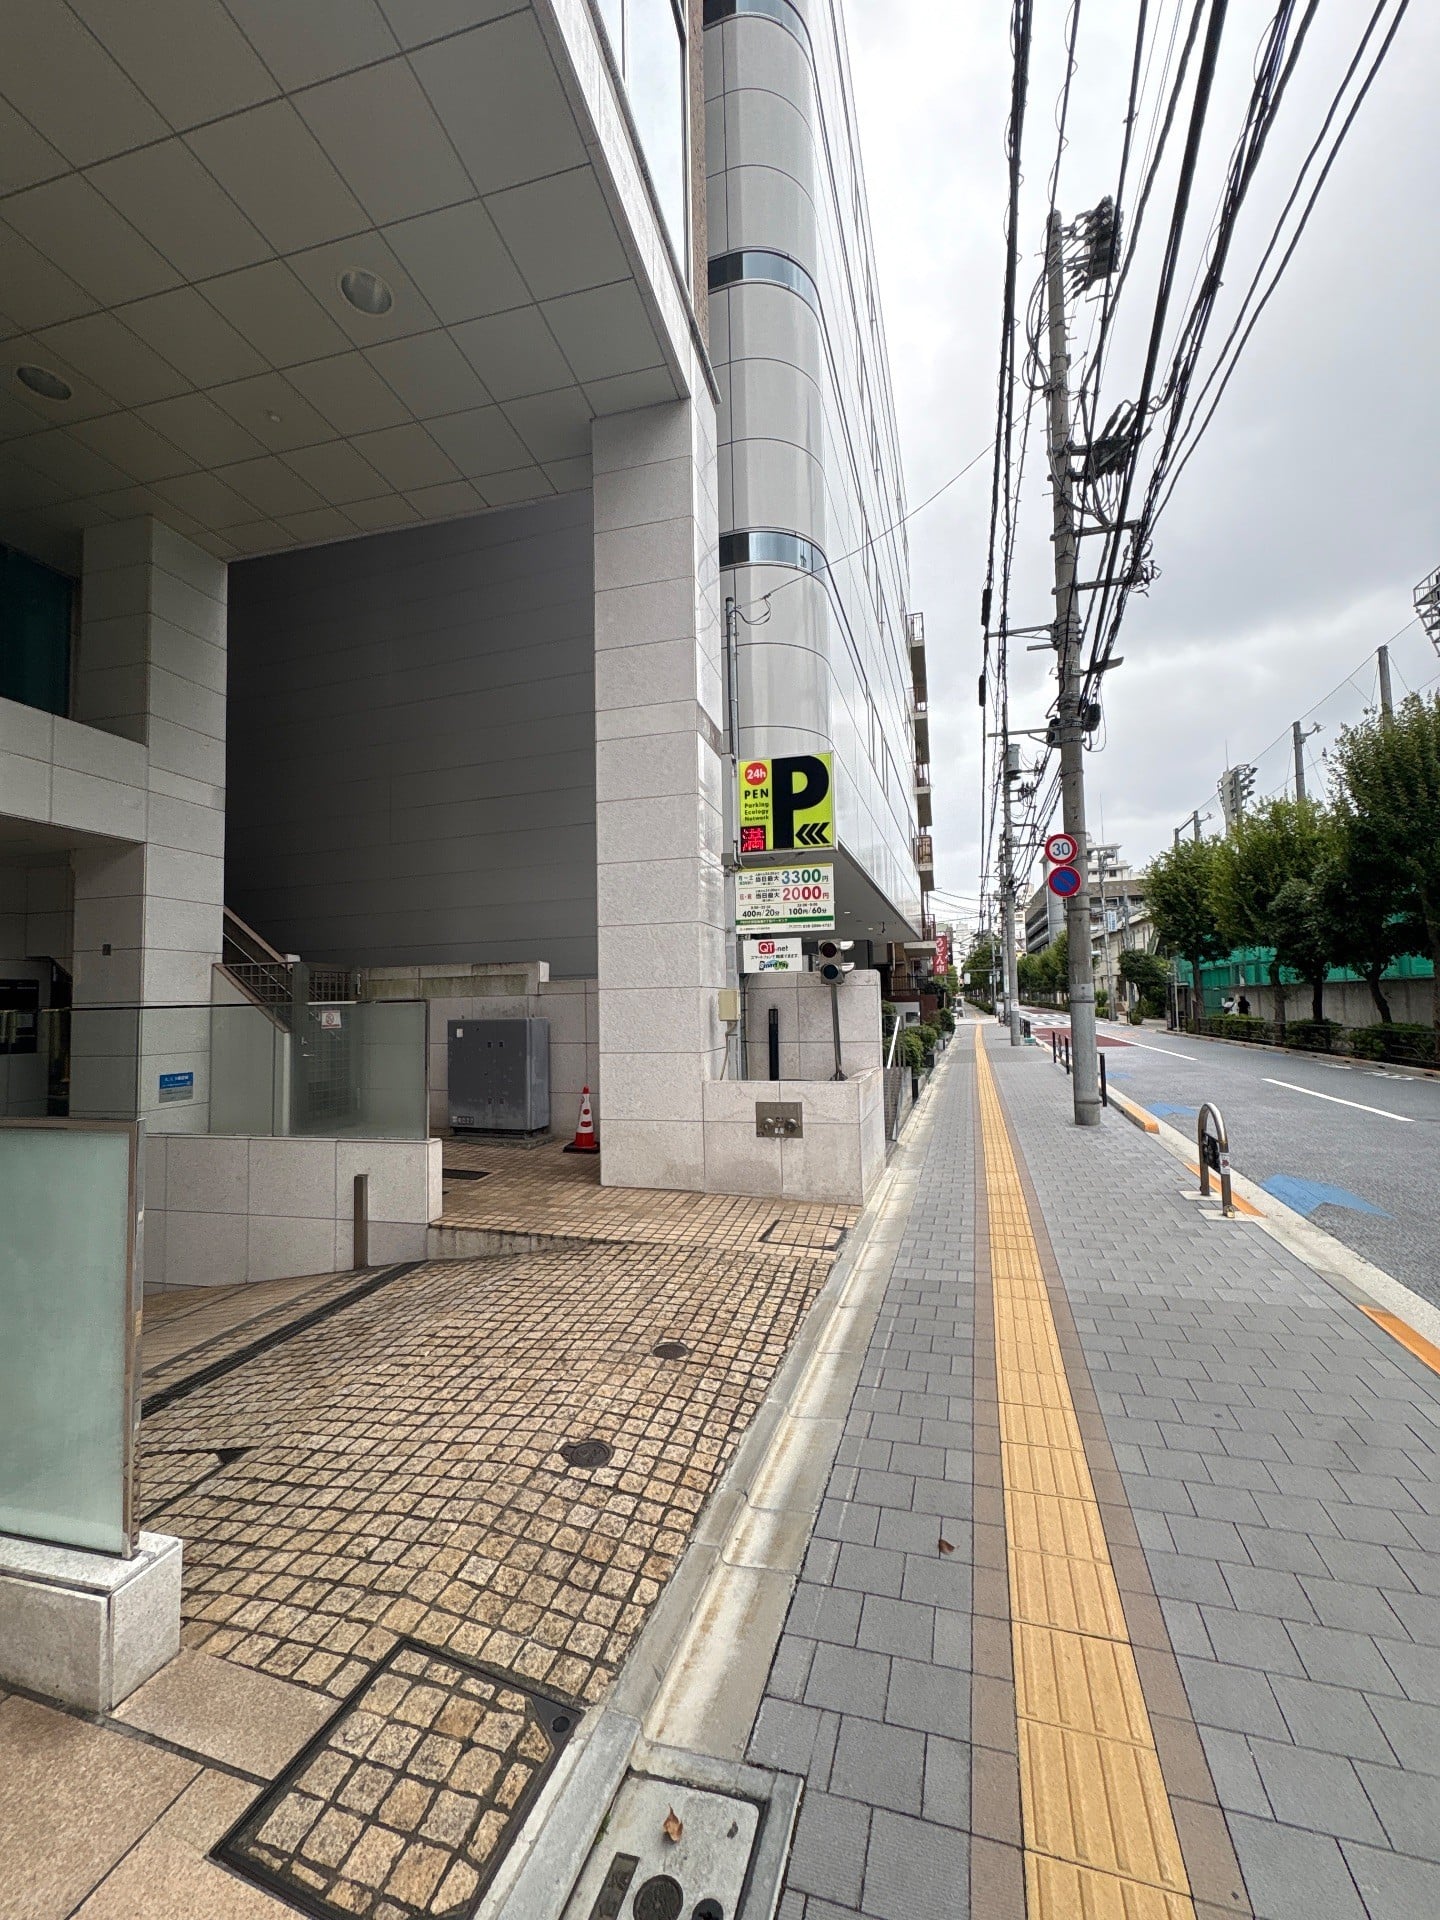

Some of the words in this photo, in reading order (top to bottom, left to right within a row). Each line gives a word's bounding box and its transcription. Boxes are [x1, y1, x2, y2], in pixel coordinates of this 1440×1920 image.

[746, 768, 766, 780] 24h
[744, 788, 769, 800] PEN
[744, 801, 769, 809] Parking
[771, 755, 829, 849] P
[1052, 842, 1070, 856] 30
[936, 938, 944, 974] うどん市
